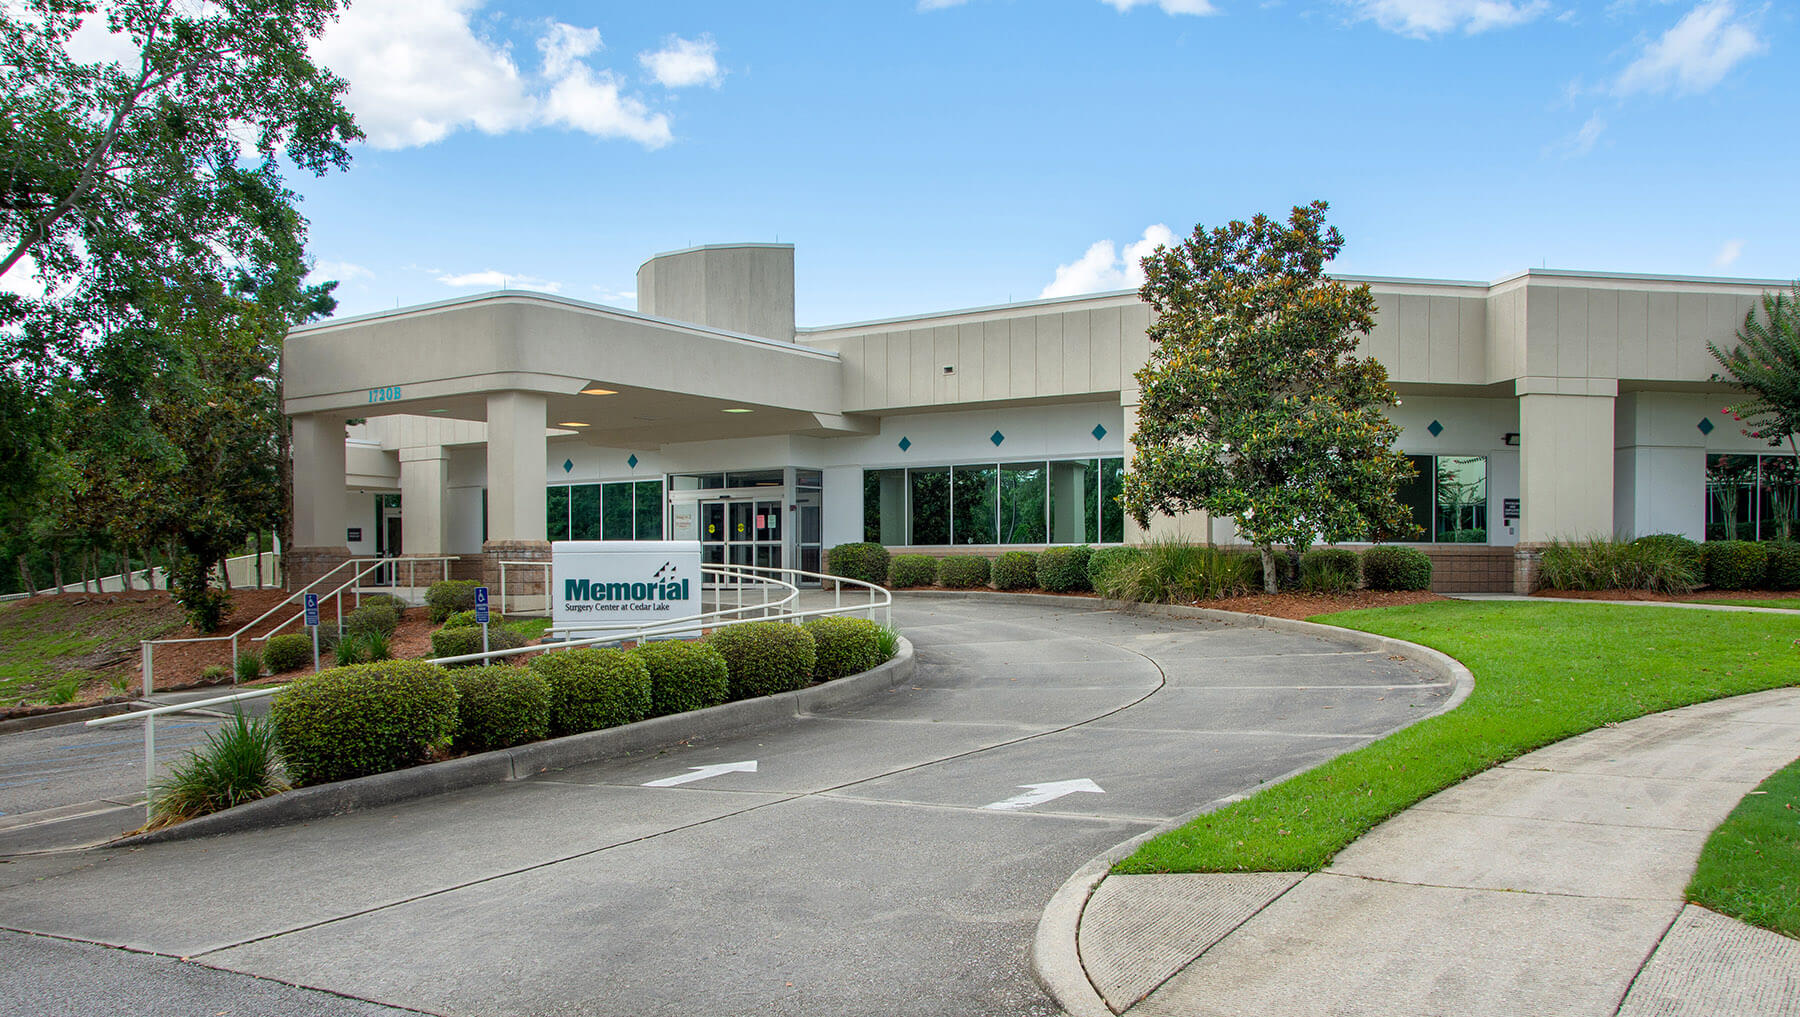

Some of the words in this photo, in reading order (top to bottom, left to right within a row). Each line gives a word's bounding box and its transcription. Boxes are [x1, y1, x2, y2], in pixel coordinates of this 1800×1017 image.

[368, 386, 401, 402] 1720B
[565, 577, 689, 601] Memorial
[565, 602, 593, 612] Surgery
[595, 602, 620, 611] Center
[620, 603, 628, 611] at
[629, 602, 651, 611] Cedar
[652, 602, 670, 611] Lake
